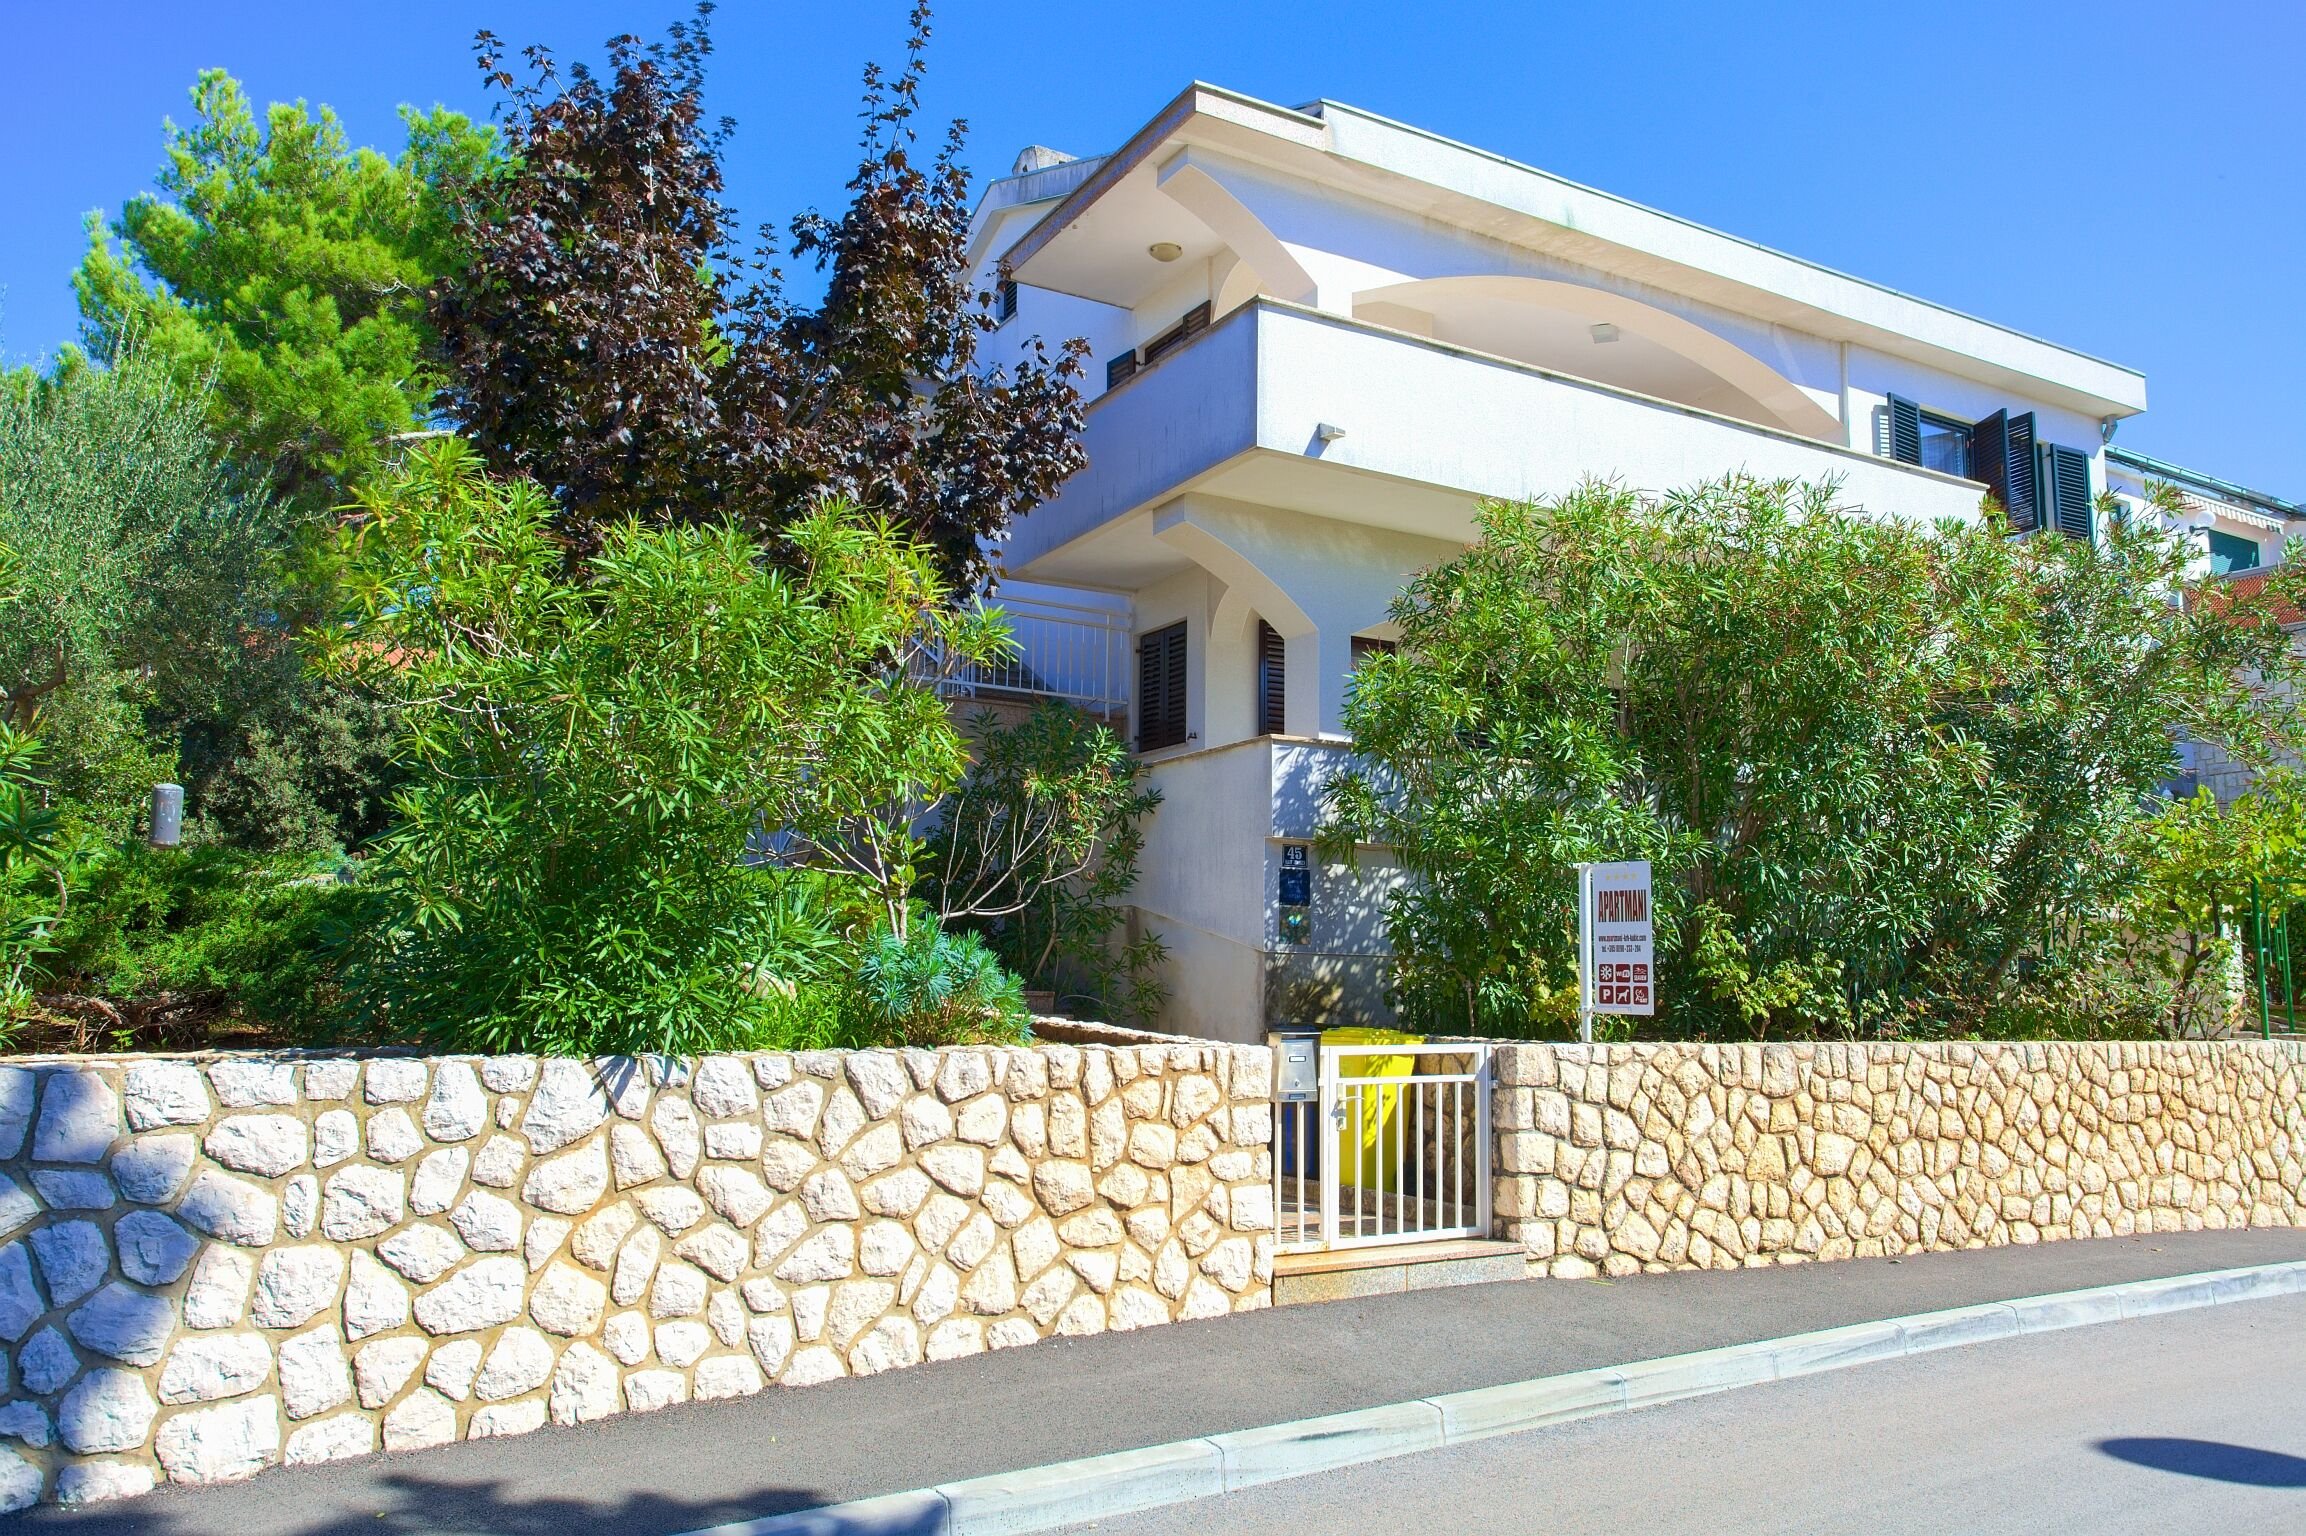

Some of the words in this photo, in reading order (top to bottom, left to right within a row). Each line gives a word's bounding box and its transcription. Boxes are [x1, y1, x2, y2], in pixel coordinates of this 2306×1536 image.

[1287, 847, 1302, 859] 45
[1599, 890, 1647, 922] APARTMANI
[1603, 989, 1610, 1000] P
